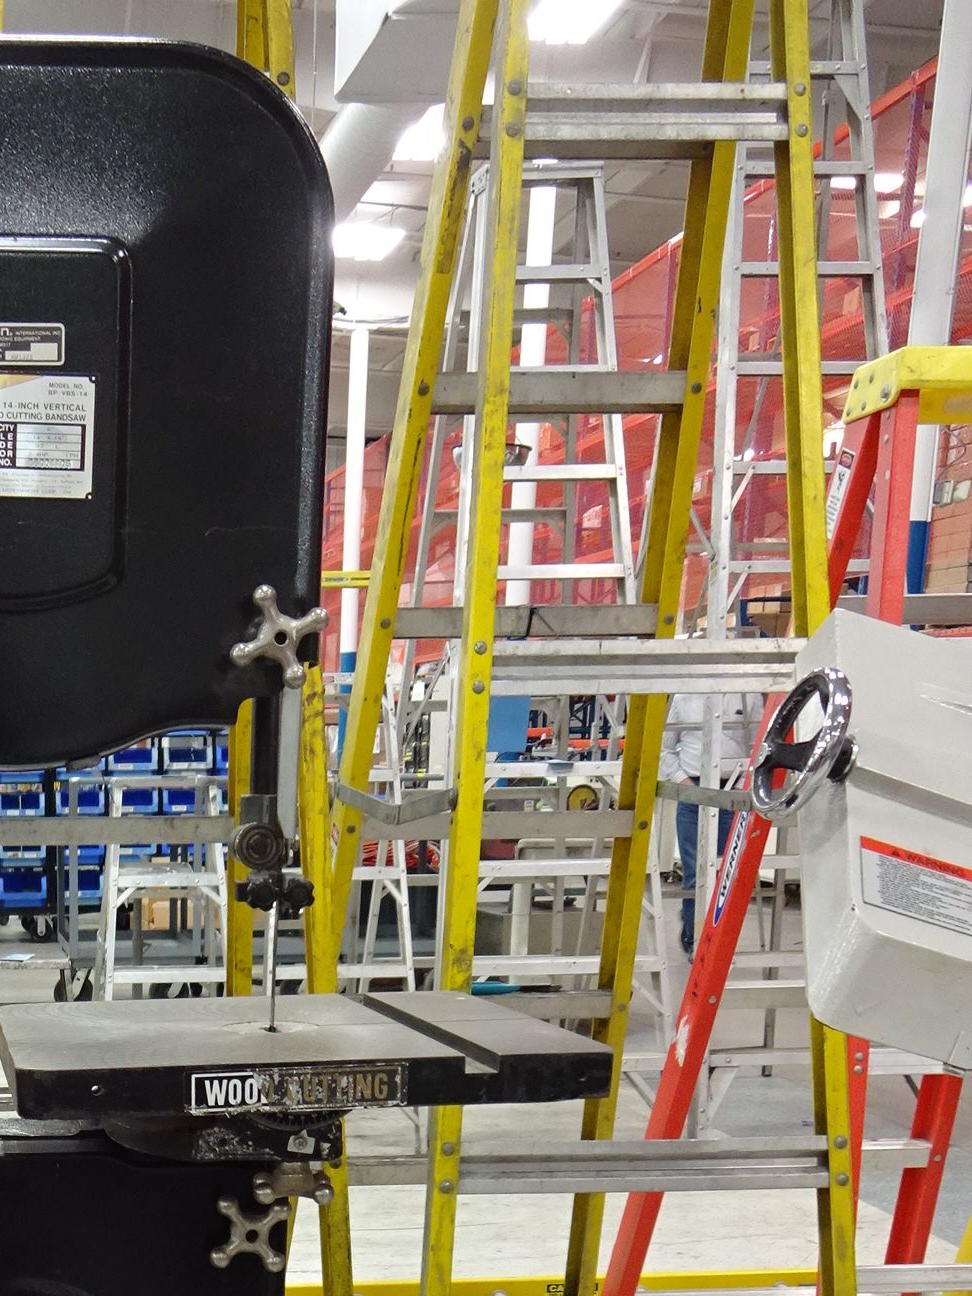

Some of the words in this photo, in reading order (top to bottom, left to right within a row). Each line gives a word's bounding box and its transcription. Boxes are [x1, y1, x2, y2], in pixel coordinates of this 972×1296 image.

[3, 402, 40, 410] 14-INCH
[43, 402, 87, 412] VERTICAL
[6, 412, 43, 420] CUTTING
[45, 412, 86, 422] BANDSAW
